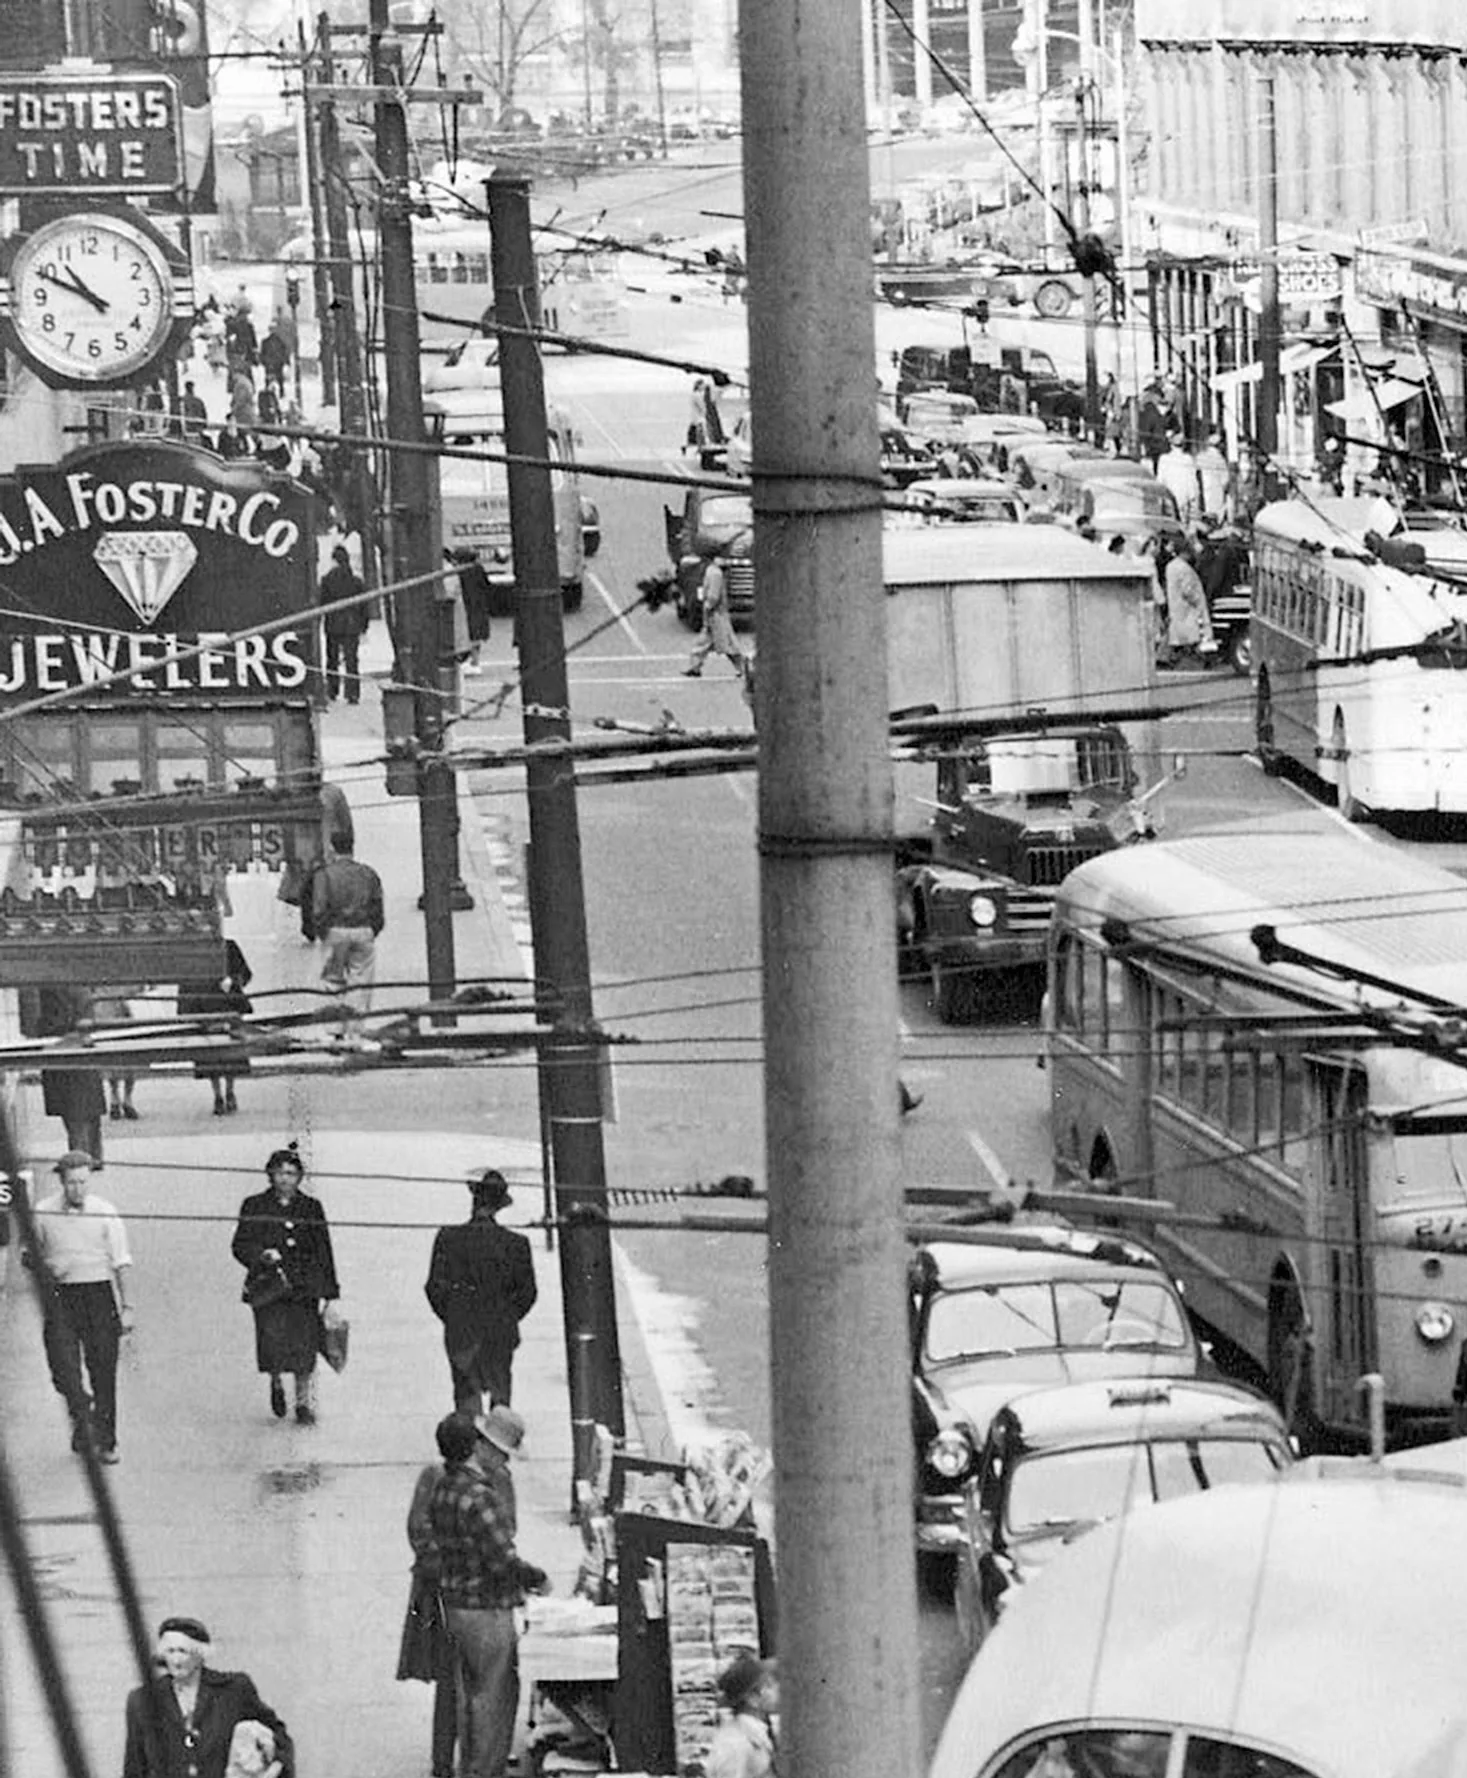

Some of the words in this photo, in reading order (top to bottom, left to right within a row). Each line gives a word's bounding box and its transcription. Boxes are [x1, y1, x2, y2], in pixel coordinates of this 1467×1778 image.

[0, 91, 168, 130] FOSTERS
[16, 141, 146, 179] TIME
[57, 245, 71, 262] 11
[80, 236, 98, 255] 12
[112, 244, 119, 262] 1
[130, 261, 142, 281] 2
[1278, 273, 1338, 293] SHOES
[33, 288, 48, 306] 9
[137, 287, 150, 307] 3
[42, 313, 56, 332] 8
[129, 314, 142, 331] 4
[64, 332, 76, 351] 7
[88, 339, 101, 358] 6
[114, 332, 128, 351] 5
[0, 631, 307, 692] JEWELERS
